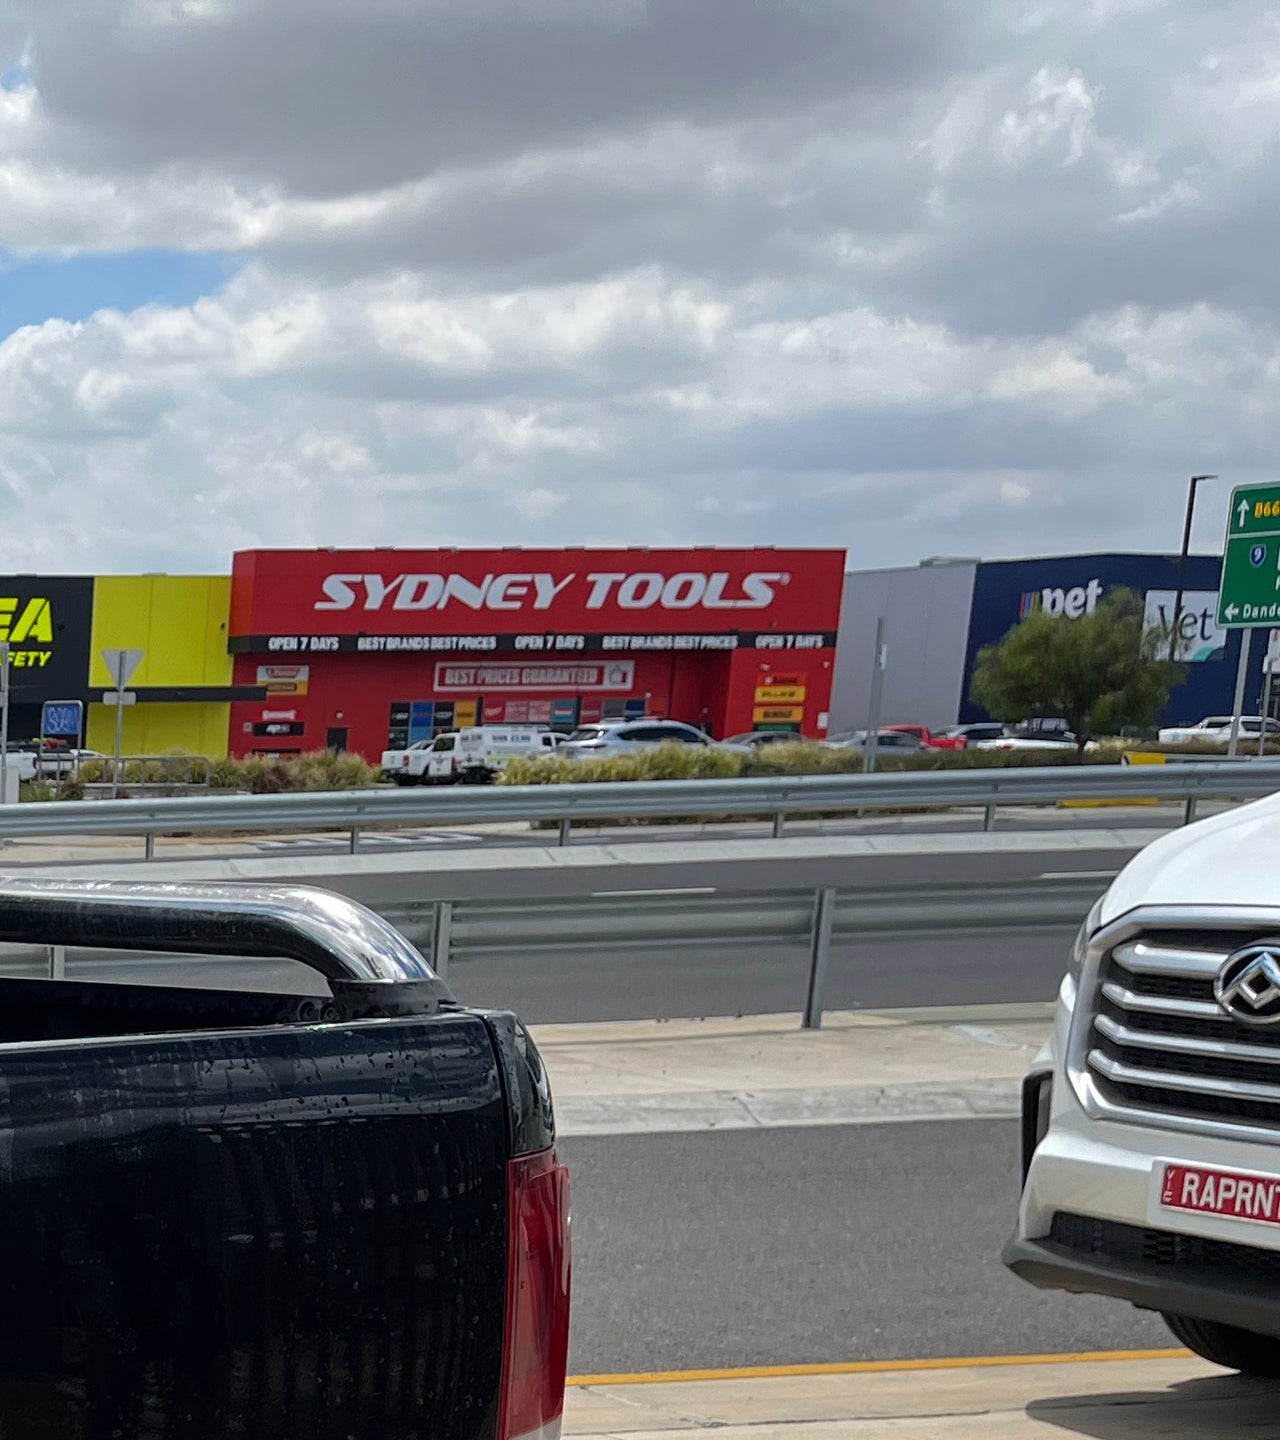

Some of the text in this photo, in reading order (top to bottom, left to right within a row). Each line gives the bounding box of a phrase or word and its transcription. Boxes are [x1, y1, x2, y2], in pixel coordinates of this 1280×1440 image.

[313, 573, 576, 610] SYDNEY
[1157, 604, 1214, 641] Vet
[268, 637, 339, 650] OPEN 7 DAYS
[357, 636, 497, 650] BEST BRANDS BEST PRICES
[514, 636, 544, 650] OPEN
[546, 636, 554, 650] 7
[445, 669, 476, 684] BEST
